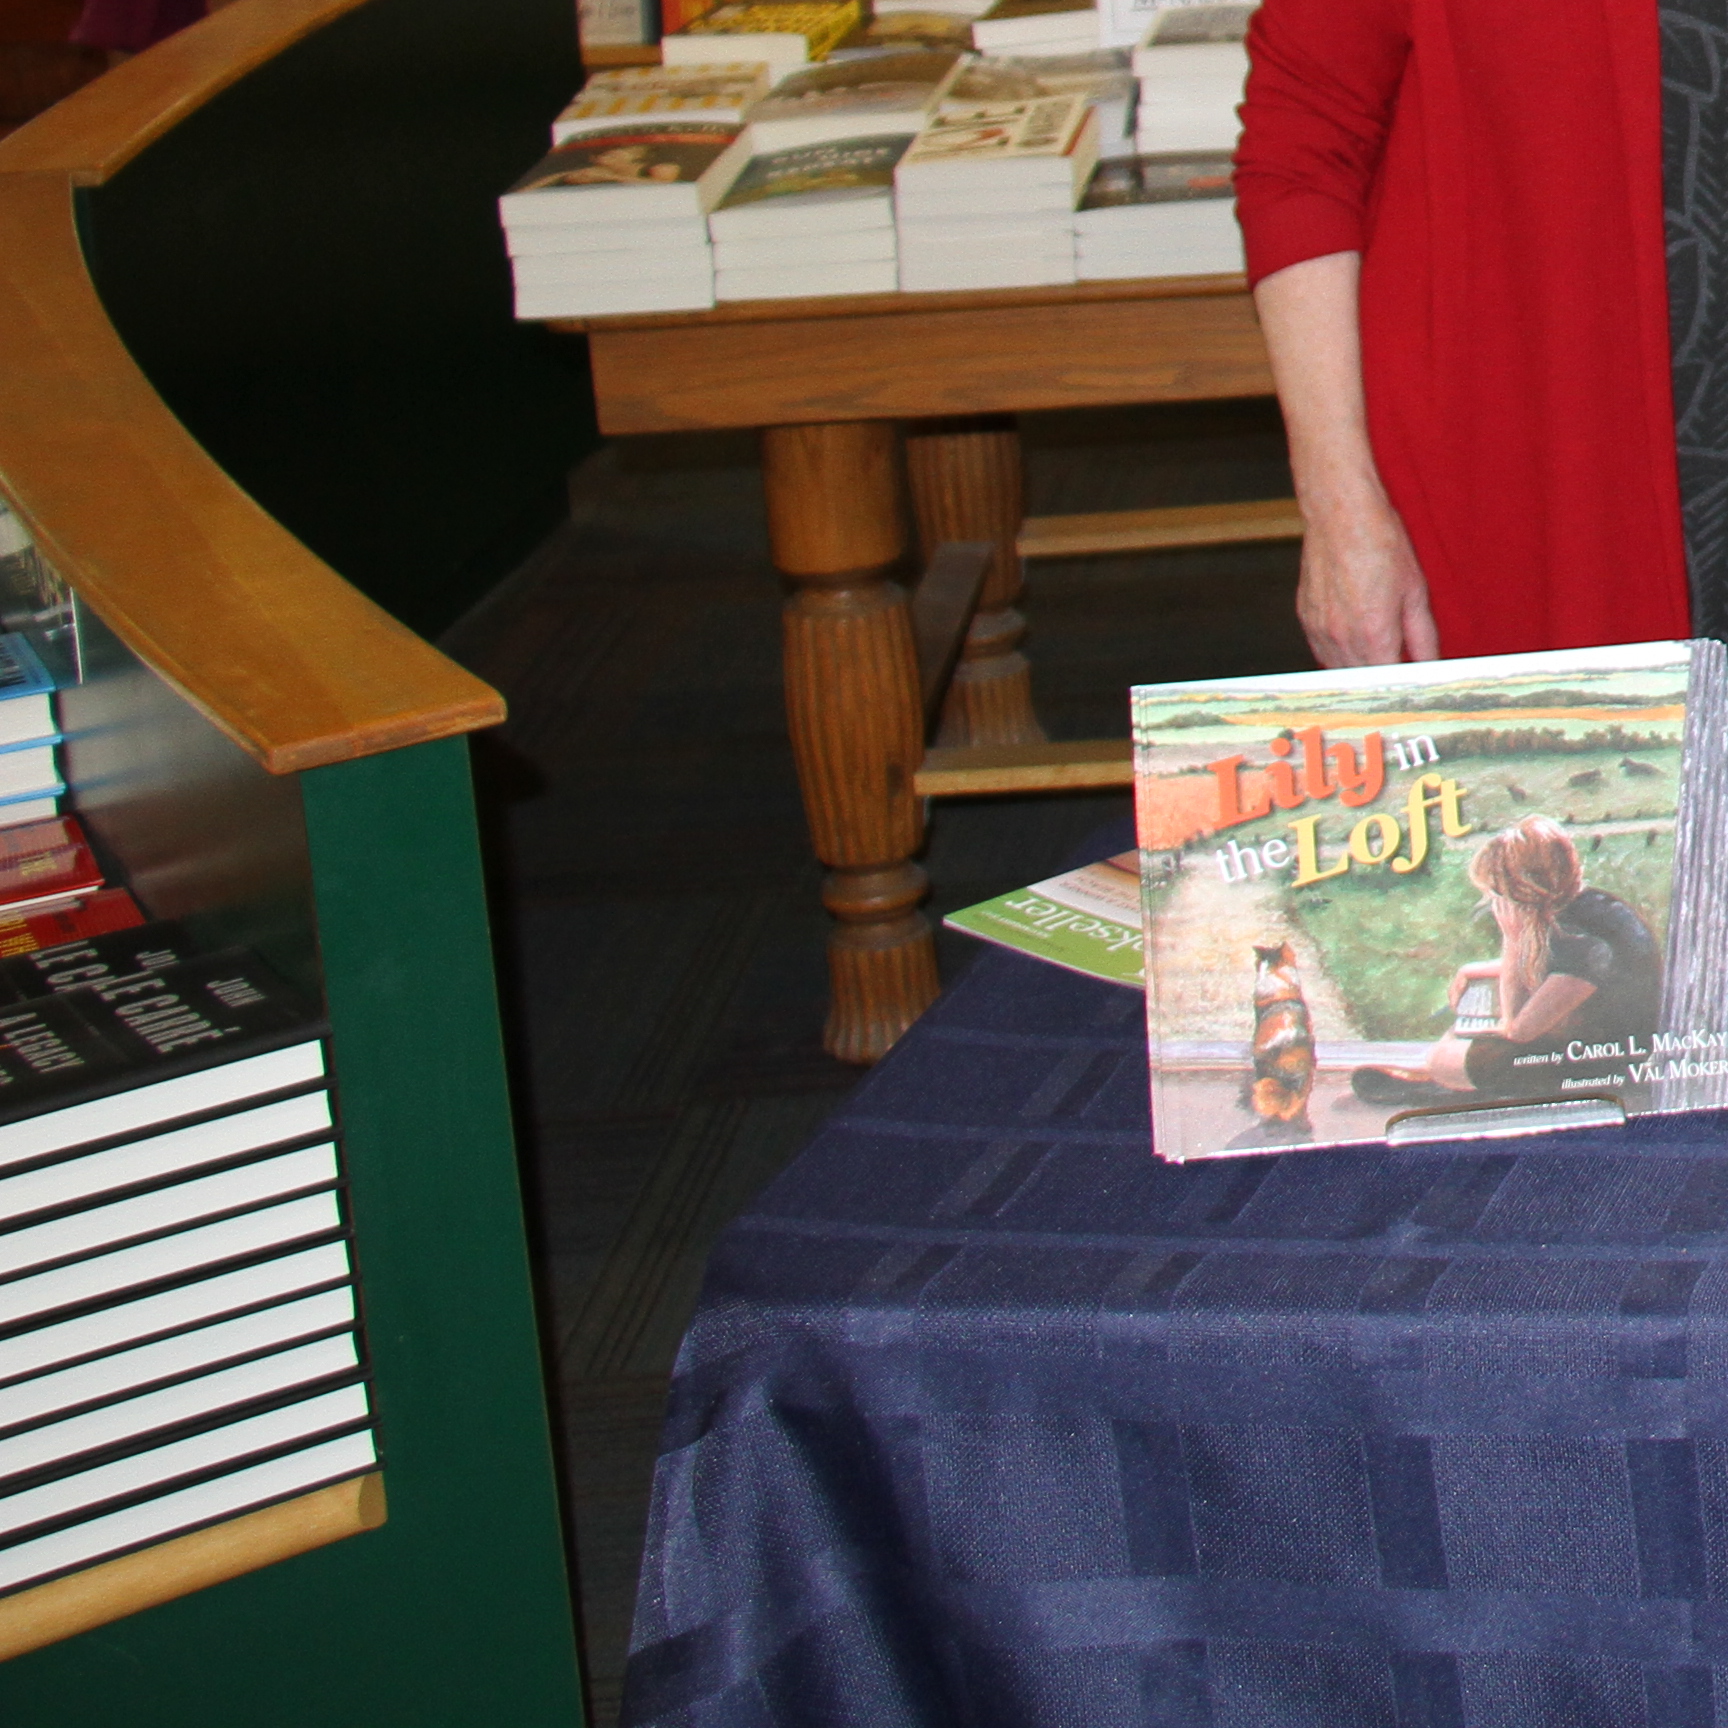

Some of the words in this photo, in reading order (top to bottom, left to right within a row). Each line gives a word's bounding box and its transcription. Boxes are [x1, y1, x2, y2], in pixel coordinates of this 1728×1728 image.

[1207, 725, 1386, 832] Lily
[1391, 731, 1442, 771] in
[1216, 838, 1291, 884] the
[1287, 772, 1473, 888] Loft
[94, 971, 166, 1003] LE
[205, 977, 266, 1008] JOHN
[114, 992, 242, 1054] CARRÉ
[3, 1023, 86, 1074] LEGACY
[1513, 1052, 1548, 1068] written
[1550, 1050, 1565, 1066] by
[1628, 1035, 1647, 1056] L.
[1561, 1074, 1611, 1090] illustrated
[1612, 1073, 1626, 1087] by
